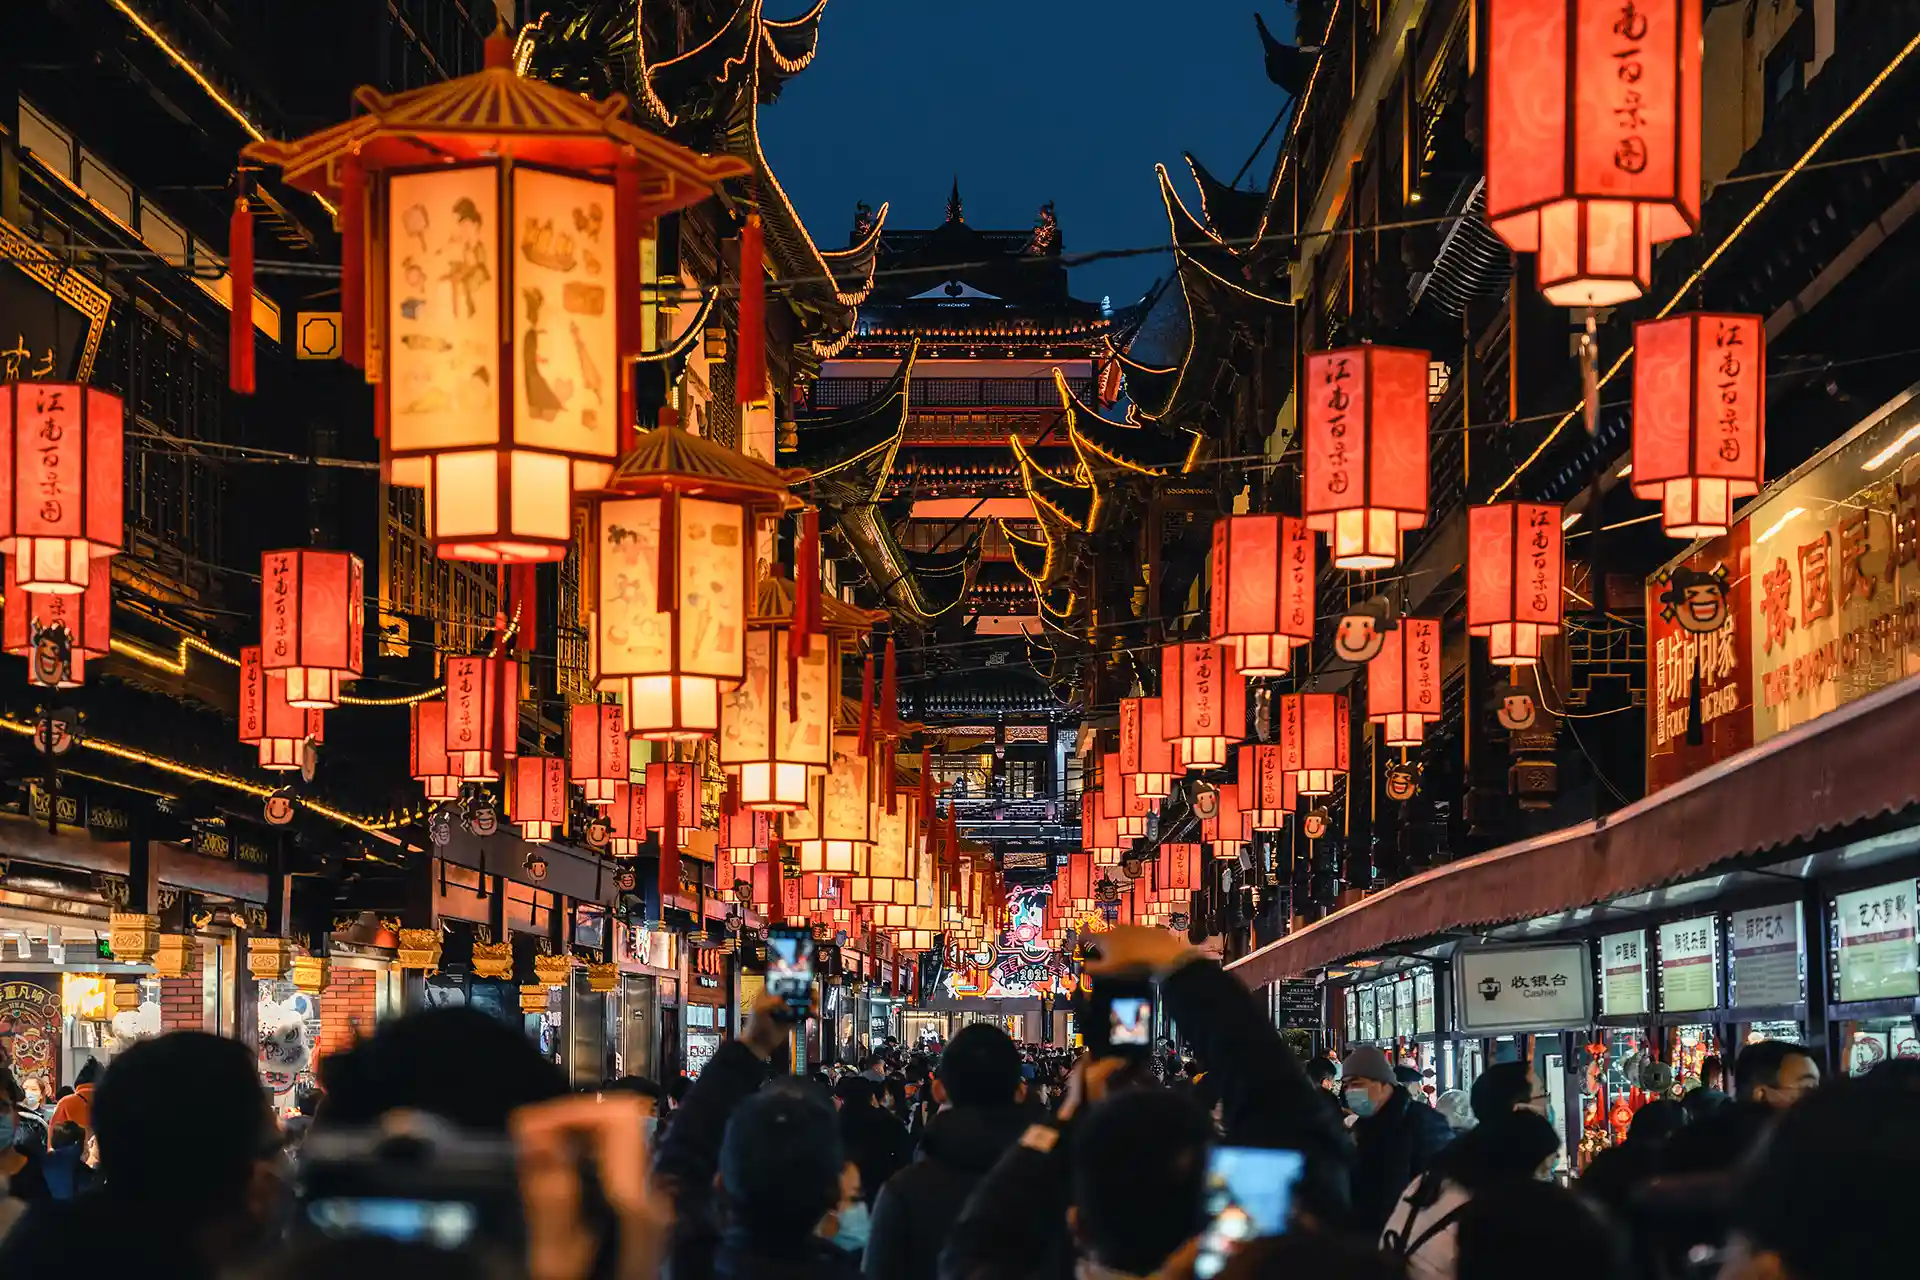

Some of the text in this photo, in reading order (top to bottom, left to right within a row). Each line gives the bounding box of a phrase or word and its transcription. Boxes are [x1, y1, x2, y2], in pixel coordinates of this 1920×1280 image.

[1666, 708, 1685, 741] FOLK
[1019, 968, 1048, 981] 2021
[1510, 973, 1569, 989] 收银台
[1523, 988, 1558, 999] Cashier
